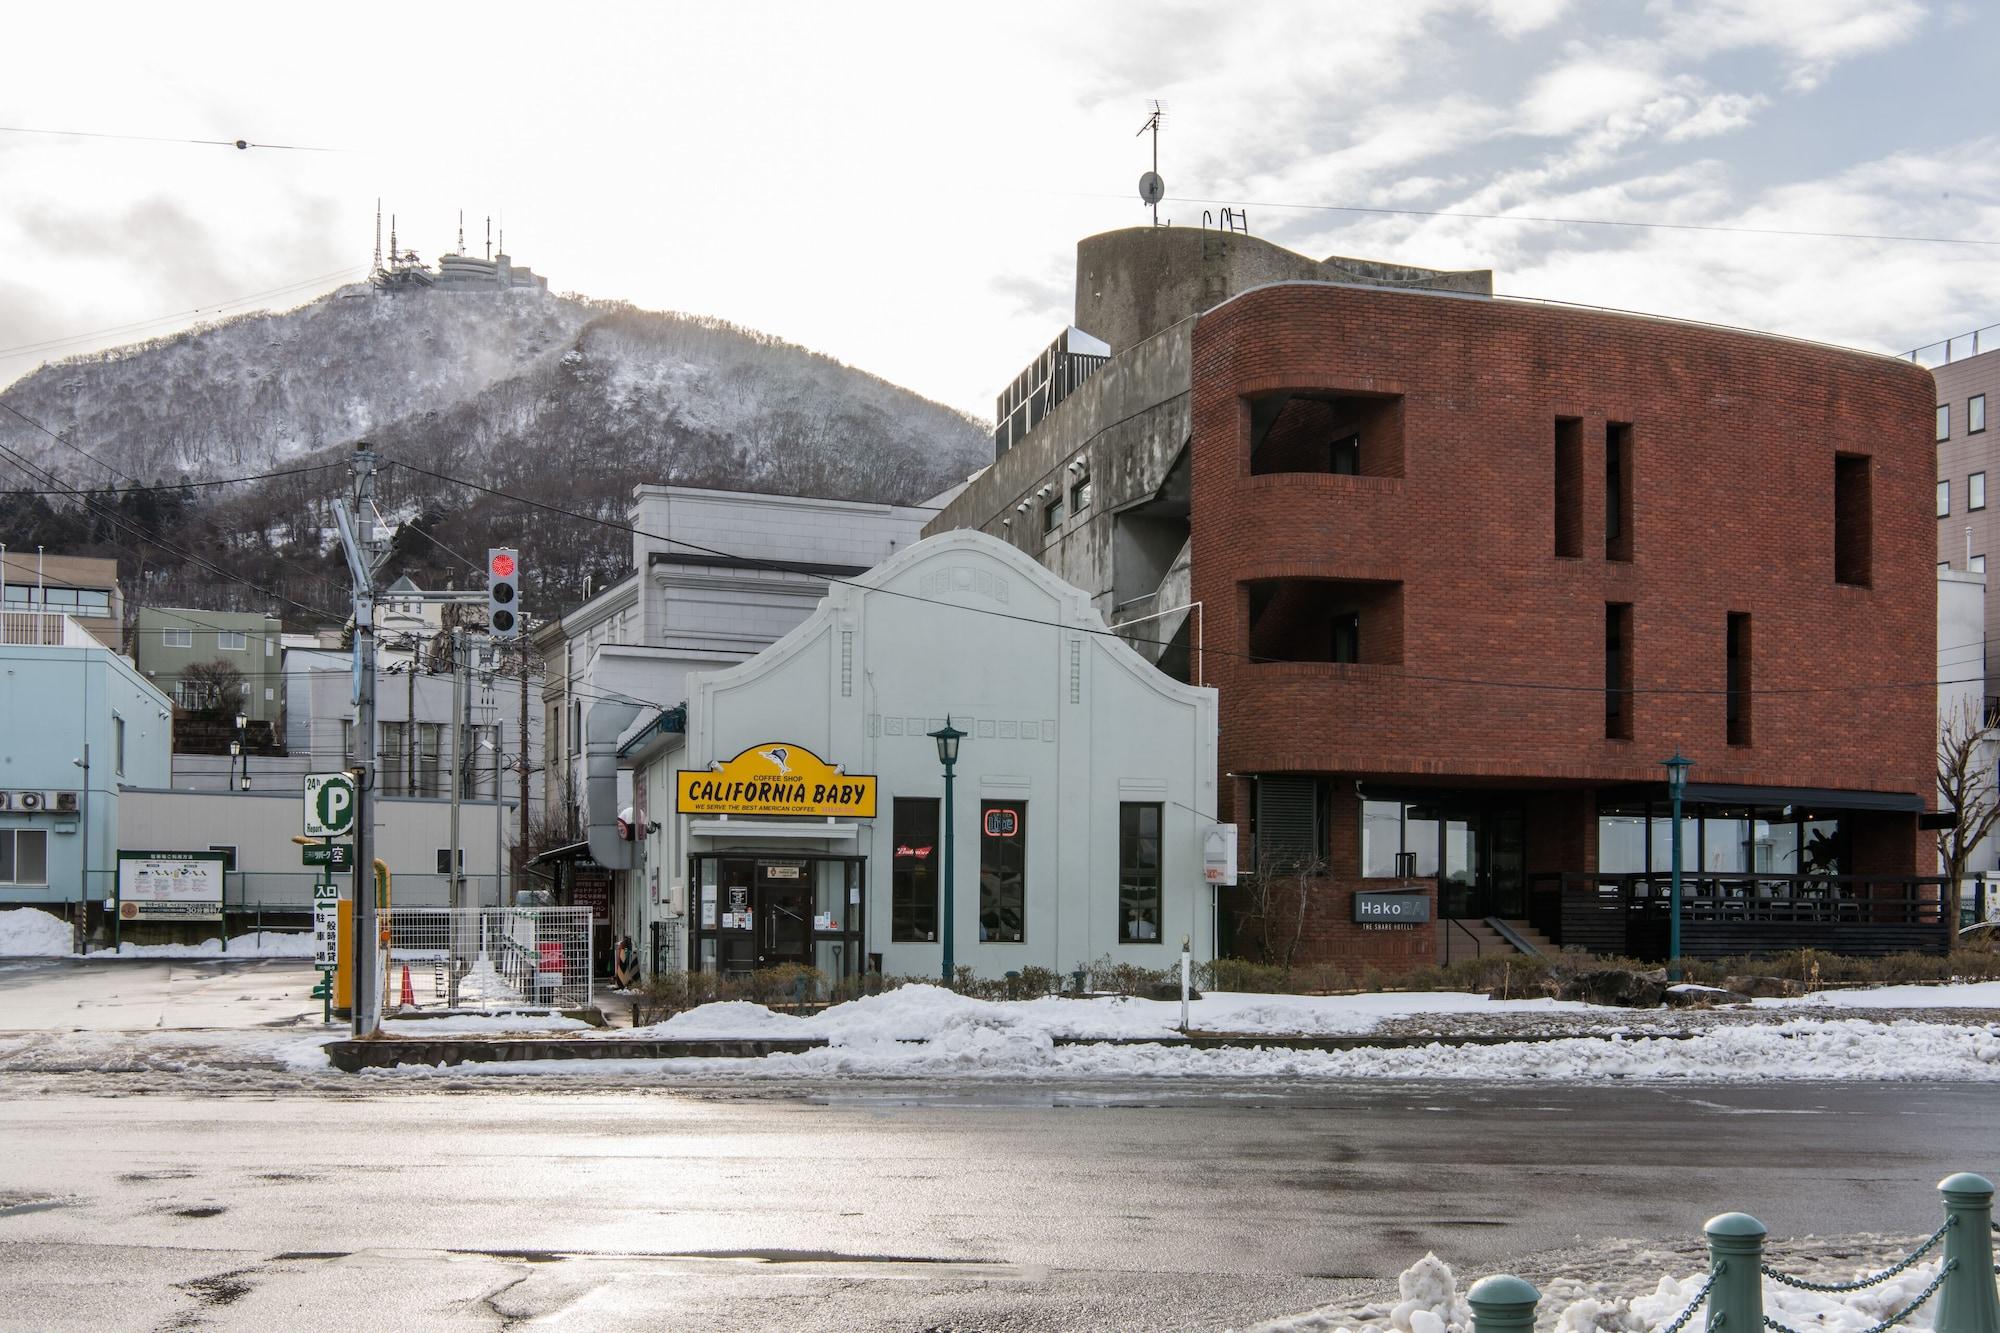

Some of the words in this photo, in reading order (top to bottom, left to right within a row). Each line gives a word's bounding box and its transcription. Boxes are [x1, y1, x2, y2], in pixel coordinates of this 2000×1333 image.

[783, 775, 803, 783] SHOP
[688, 781, 806, 804] CALIFORNIA
[812, 784, 866, 805] BABY
[328, 786, 350, 825] P
[331, 846, 344, 862] 空
[316, 886, 337, 898] 入口
[1363, 923, 1373, 931] THE
[1374, 923, 1392, 931] SHARE
[1393, 923, 1414, 931] HOTELS
[316, 913, 325, 962] 駐車場
[327, 914, 336, 962] 一般時間貸
